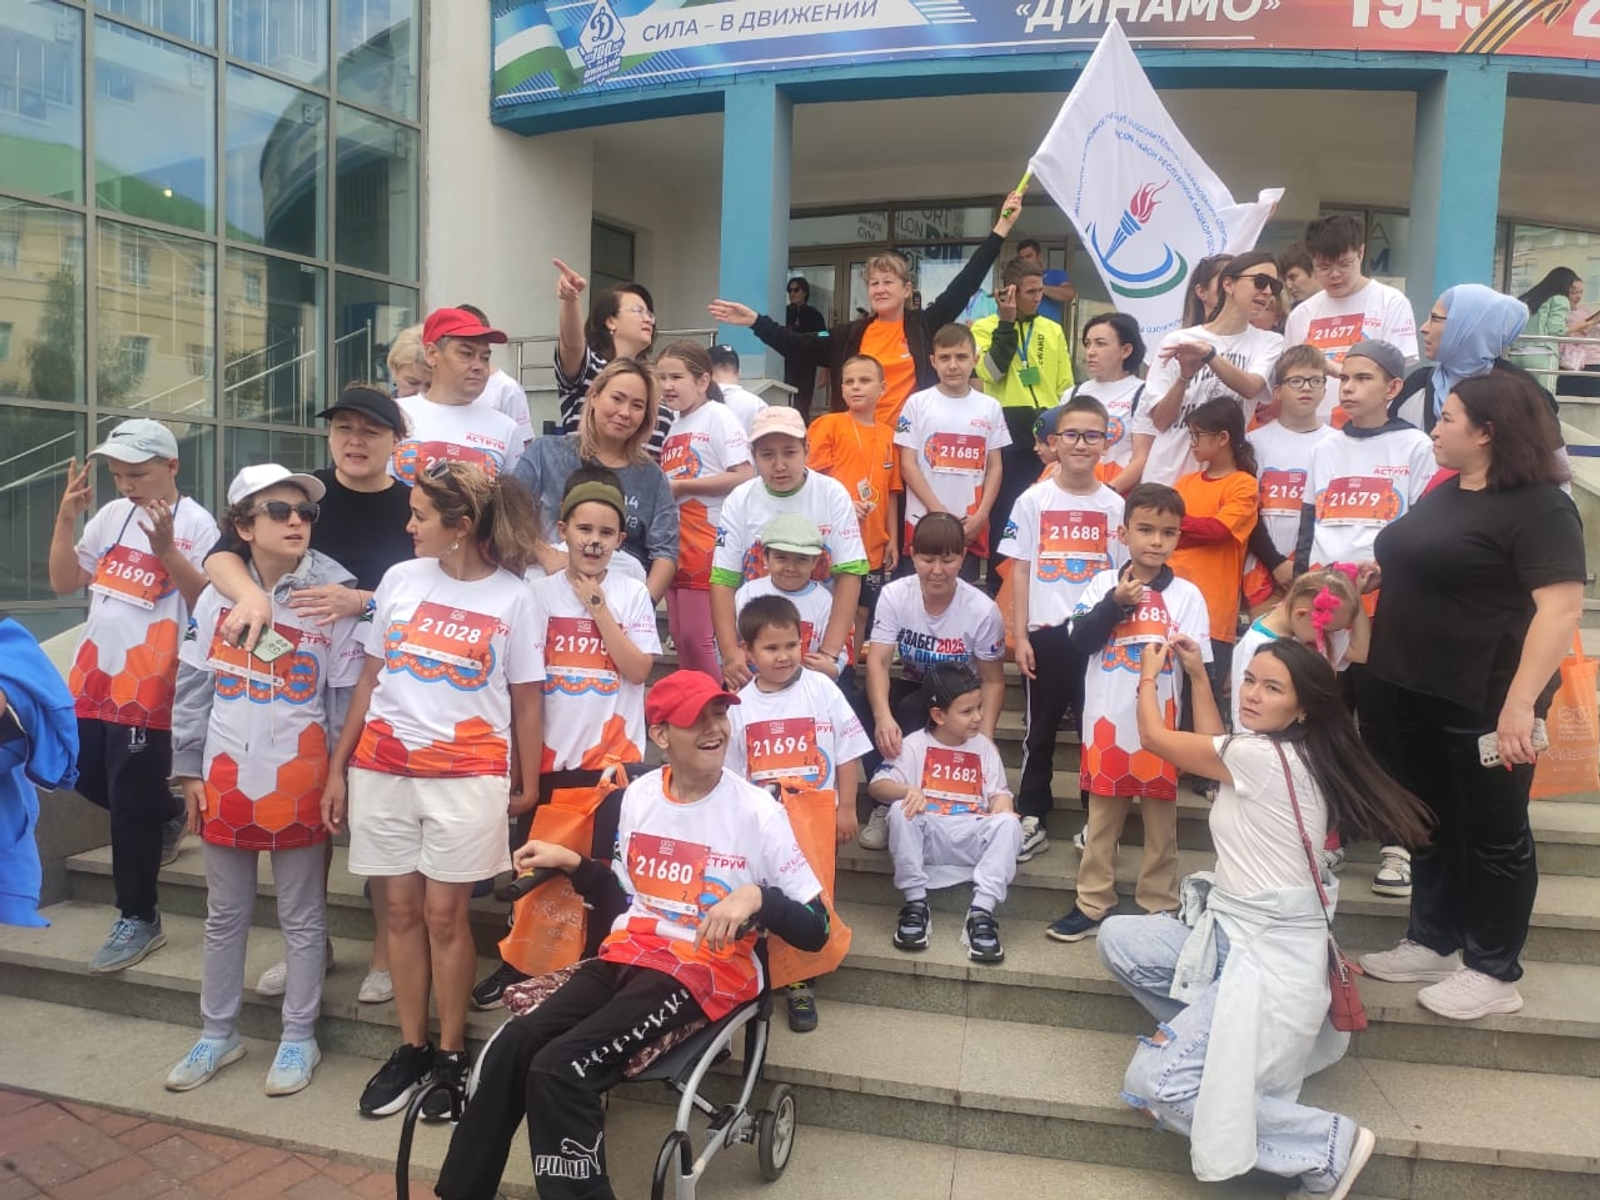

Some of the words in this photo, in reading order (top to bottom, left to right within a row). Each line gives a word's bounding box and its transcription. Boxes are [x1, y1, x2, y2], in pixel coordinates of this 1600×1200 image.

[642, 18, 698, 42] СИЛА
[720, 14, 735, 31] В
[738, 0, 878, 33] ДВИЖЕНИИ
[1313, 326, 1355, 340] 21677
[940, 446, 980, 460] 21685
[1329, 492, 1381, 507] 21679
[1049, 525, 1100, 540] 21688
[105, 560, 156, 587] 21690
[417, 617, 482, 644] 21028
[753, 735, 808, 757] 21696
[931, 764, 977, 783] 21682
[635, 855, 693, 884] 21680
[706, 856, 746, 870] ТРУМ
[536, 1154, 590, 1179] PUMA
